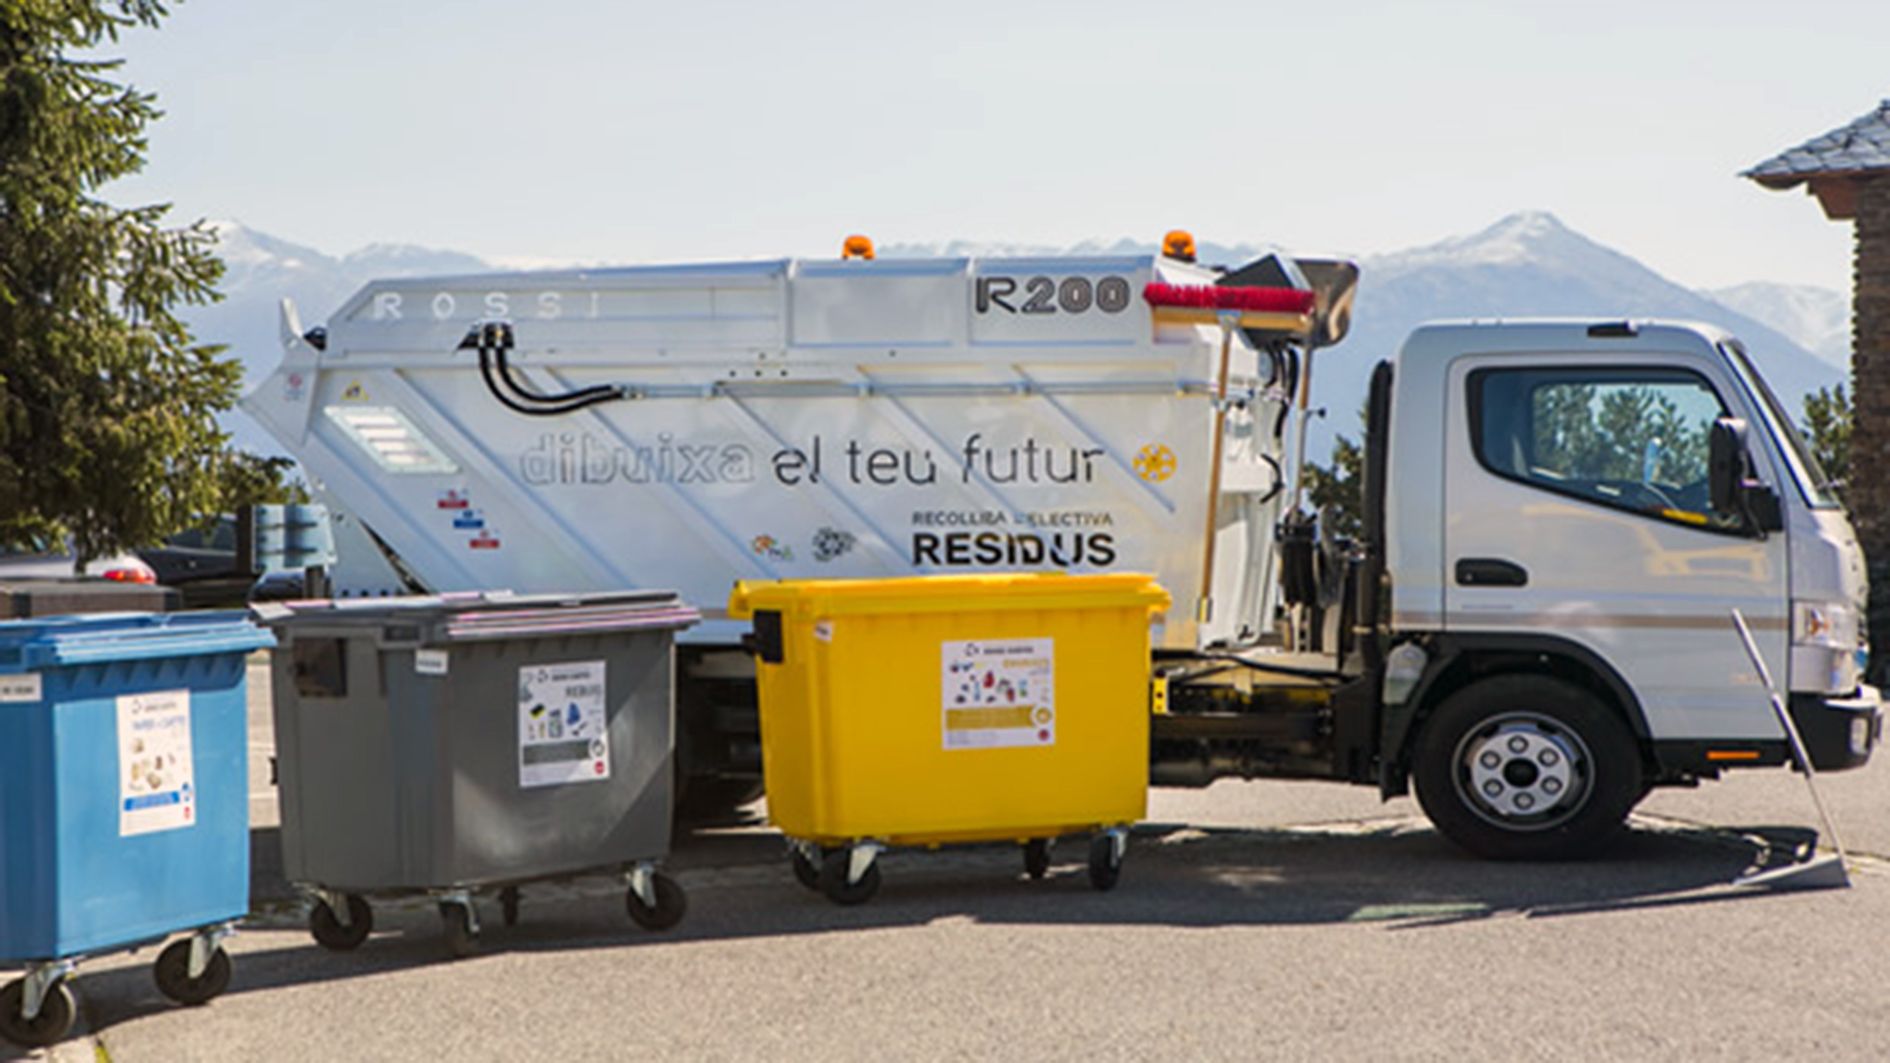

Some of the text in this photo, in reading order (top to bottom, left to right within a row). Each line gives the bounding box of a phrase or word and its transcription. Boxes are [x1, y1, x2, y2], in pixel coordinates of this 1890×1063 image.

[374, 291, 599, 320] ROSSI
[975, 275, 1131, 314] R200
[520, 432, 1104, 486] dibuixa el teu futur
[913, 532, 1116, 566] RESIDUS
